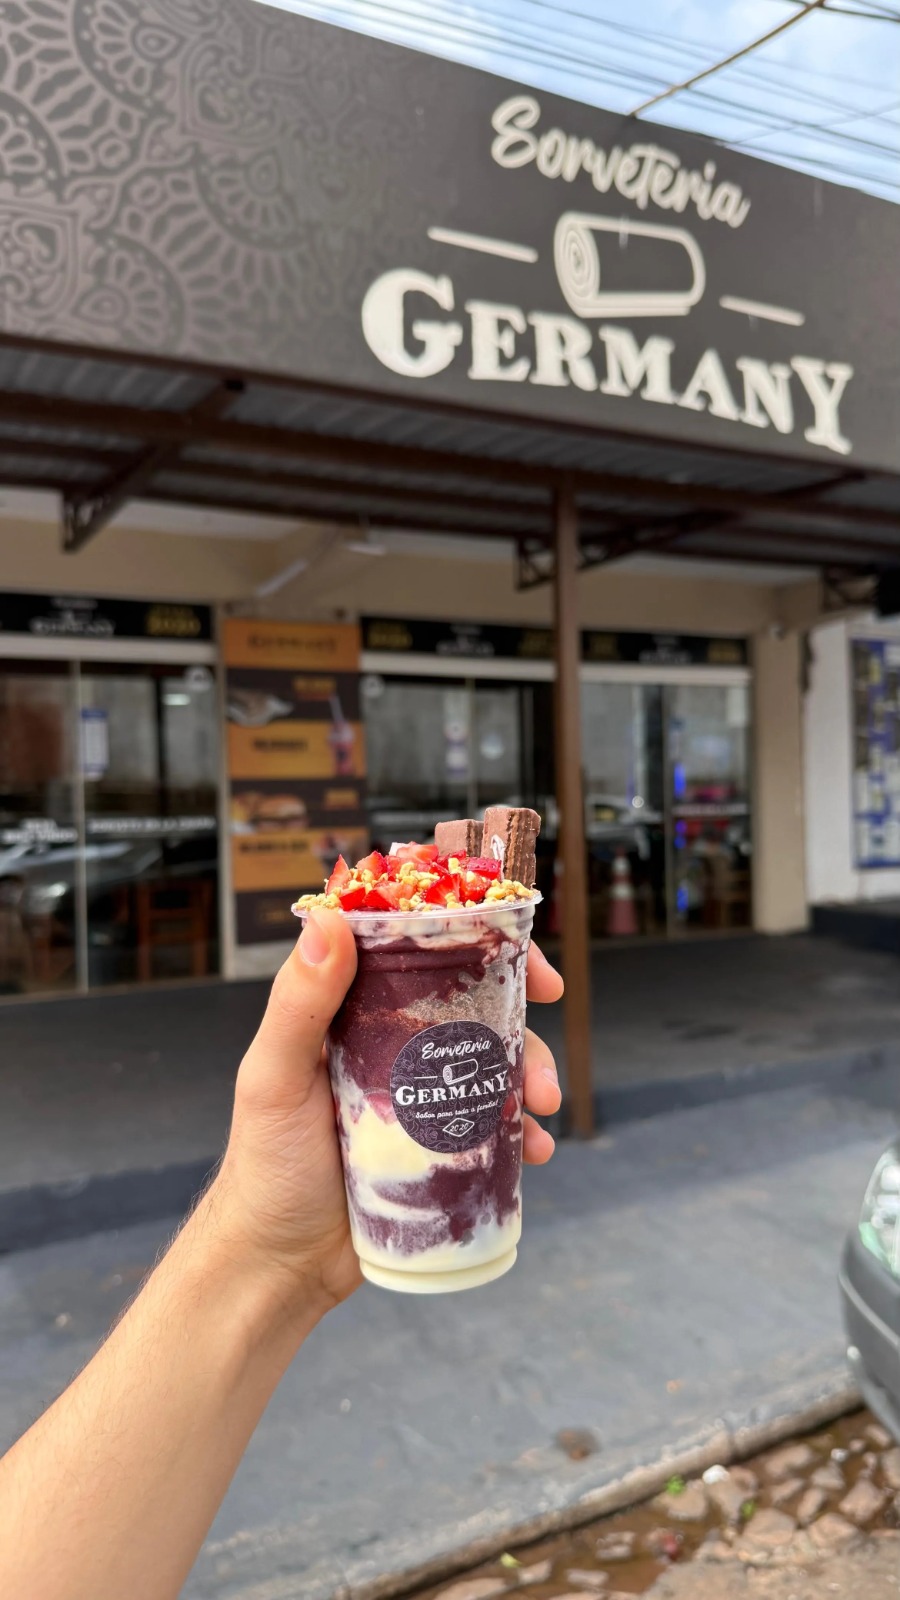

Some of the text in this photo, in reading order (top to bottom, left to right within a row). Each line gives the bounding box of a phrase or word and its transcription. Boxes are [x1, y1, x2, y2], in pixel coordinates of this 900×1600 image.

[490, 96, 751, 228] Sorveteria
[361, 268, 853, 455] GERMANY
[421, 1038, 492, 1060] Sorveteria
[395, 1070, 508, 1106] GERMANY
[415, 1111, 435, 1119] Sabor
[436, 1111, 453, 1119] para
[455, 1107, 469, 1115] toda
